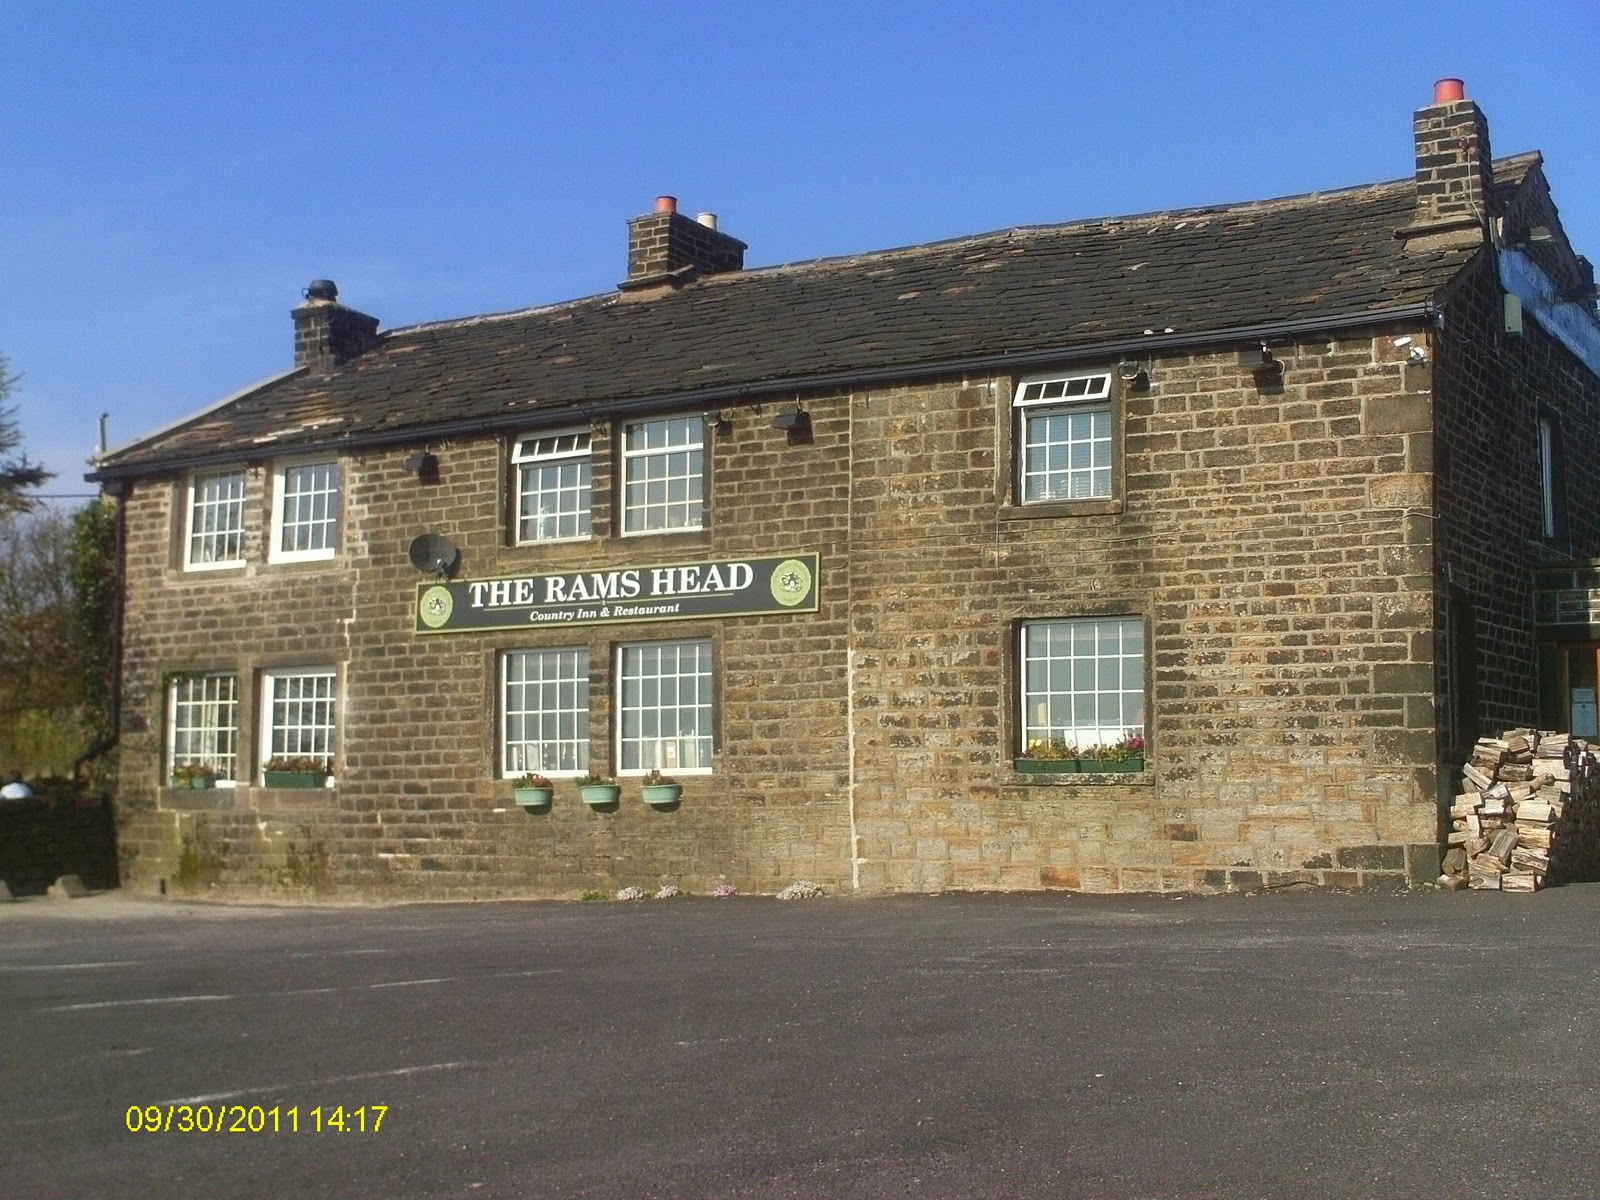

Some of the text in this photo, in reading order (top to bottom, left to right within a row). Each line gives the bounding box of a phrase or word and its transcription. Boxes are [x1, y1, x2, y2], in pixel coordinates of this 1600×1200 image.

[469, 579, 534, 608] THE
[544, 570, 641, 603] RAMS
[650, 563, 754, 596] HEAD
[530, 603, 680, 621] Country Inn & Restaurant
